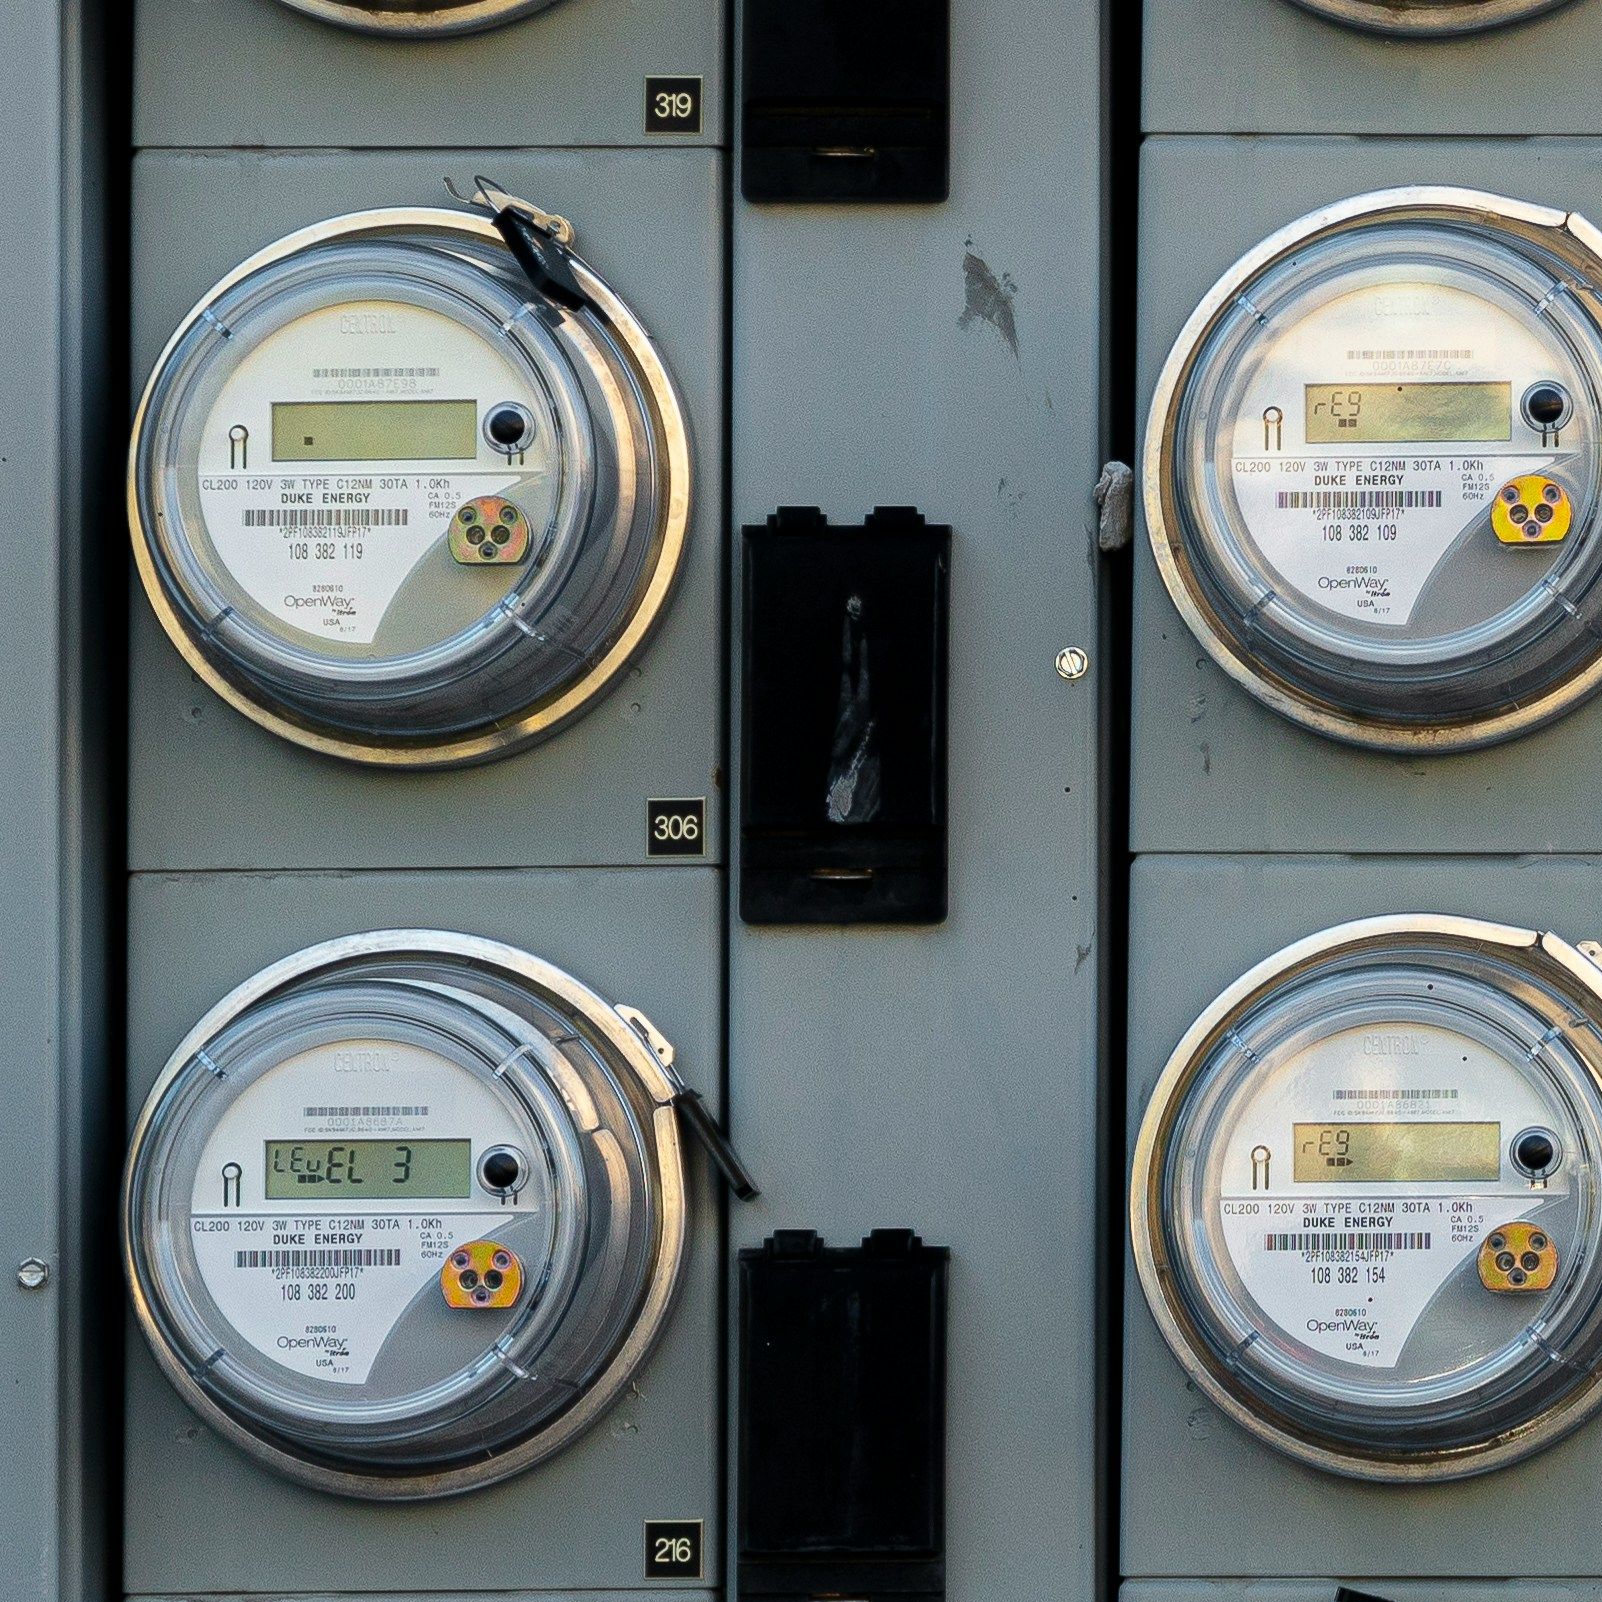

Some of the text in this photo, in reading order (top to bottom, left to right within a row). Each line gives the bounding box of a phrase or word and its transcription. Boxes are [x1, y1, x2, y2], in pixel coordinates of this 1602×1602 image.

[655, 93, 691, 117] 319
[1315, 475, 1405, 487] DUKE ENERGY
[281, 493, 371, 505] DUKE ENERGY
[1322, 525, 1397, 542] 108 382 109
[288, 543, 363, 560] 108 382 119
[1316, 577, 1386, 592] OpenWay
[655, 815, 698, 839] 306
[1303, 1216, 1394, 1228] DUKE ENERGY
[273, 1233, 363, 1245] DUKE ENERGY
[1310, 1267, 1386, 1284] 108 382 154
[281, 1284, 356, 1301] 108 382 200
[655, 1538, 690, 1562] 216
